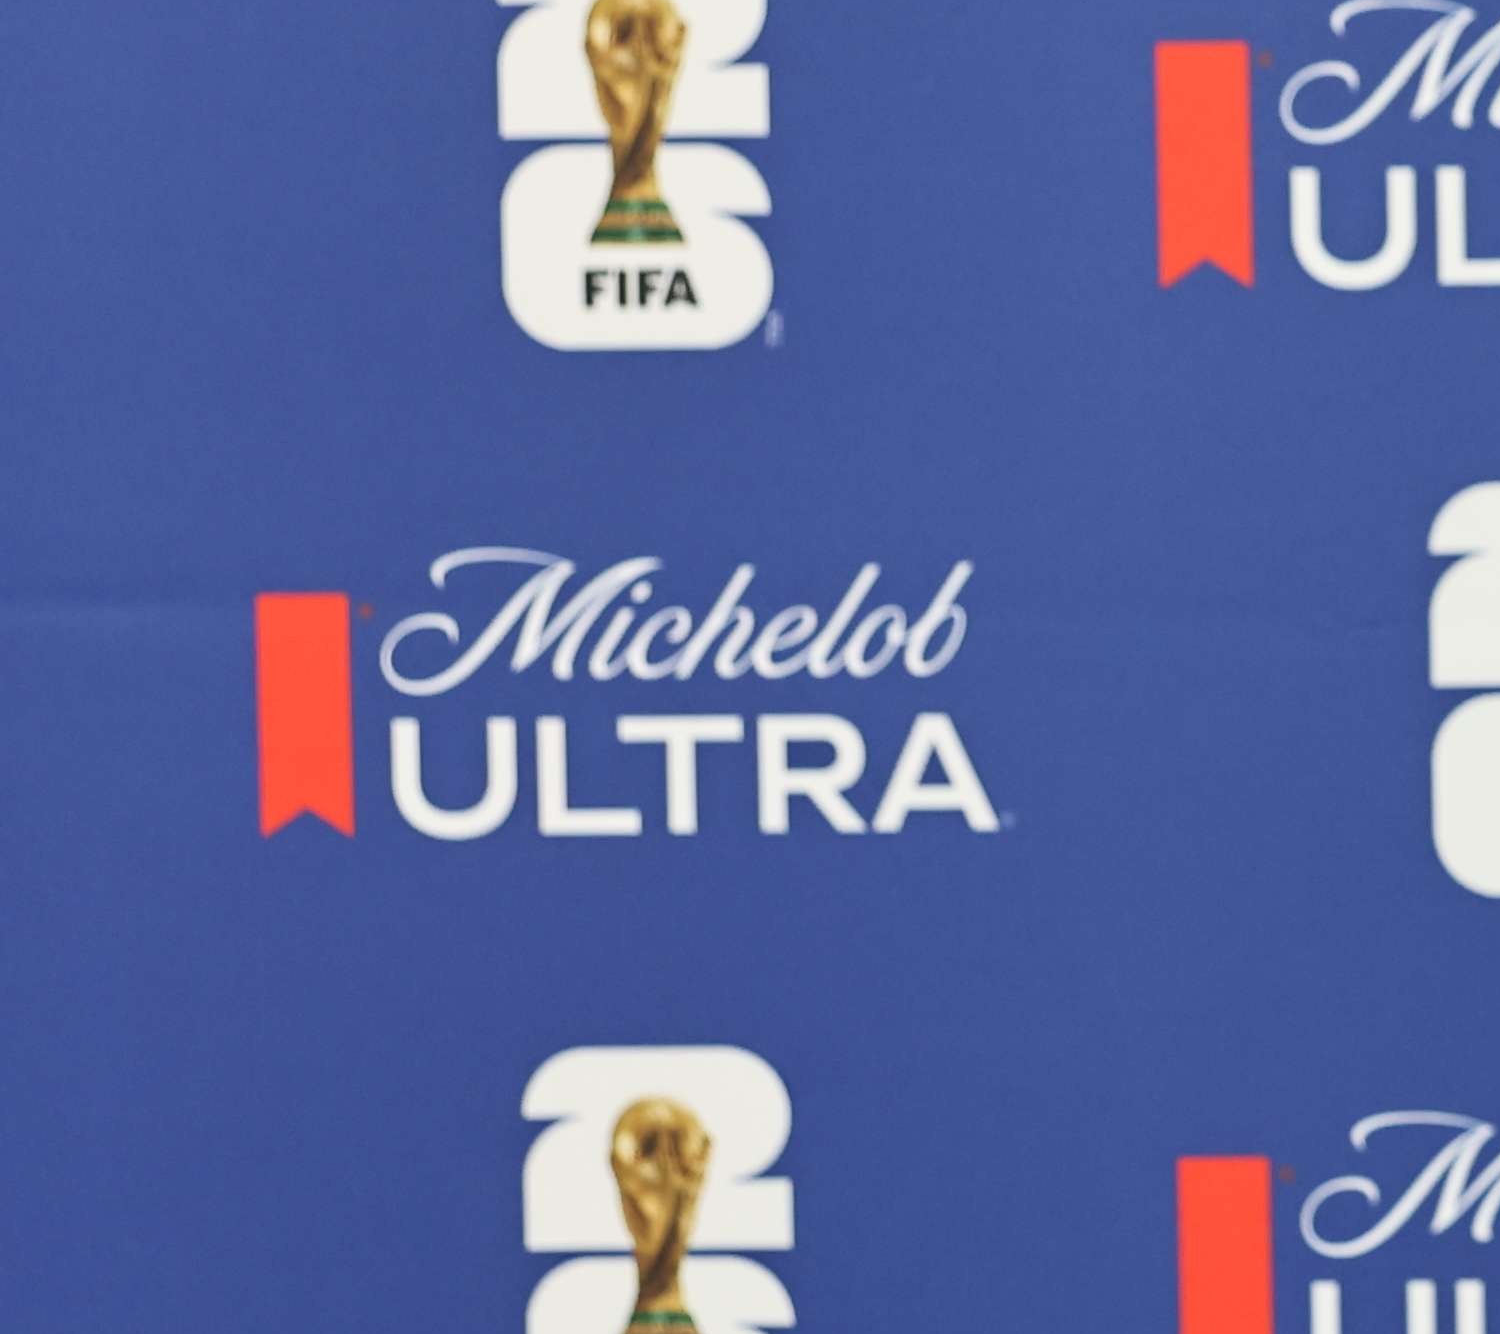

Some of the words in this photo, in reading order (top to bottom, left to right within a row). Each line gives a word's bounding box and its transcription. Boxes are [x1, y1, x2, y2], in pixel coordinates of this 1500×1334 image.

[582, 267, 700, 309] FIFA
[378, 546, 973, 697] Michelob
[389, 712, 1000, 841] ULTRA
